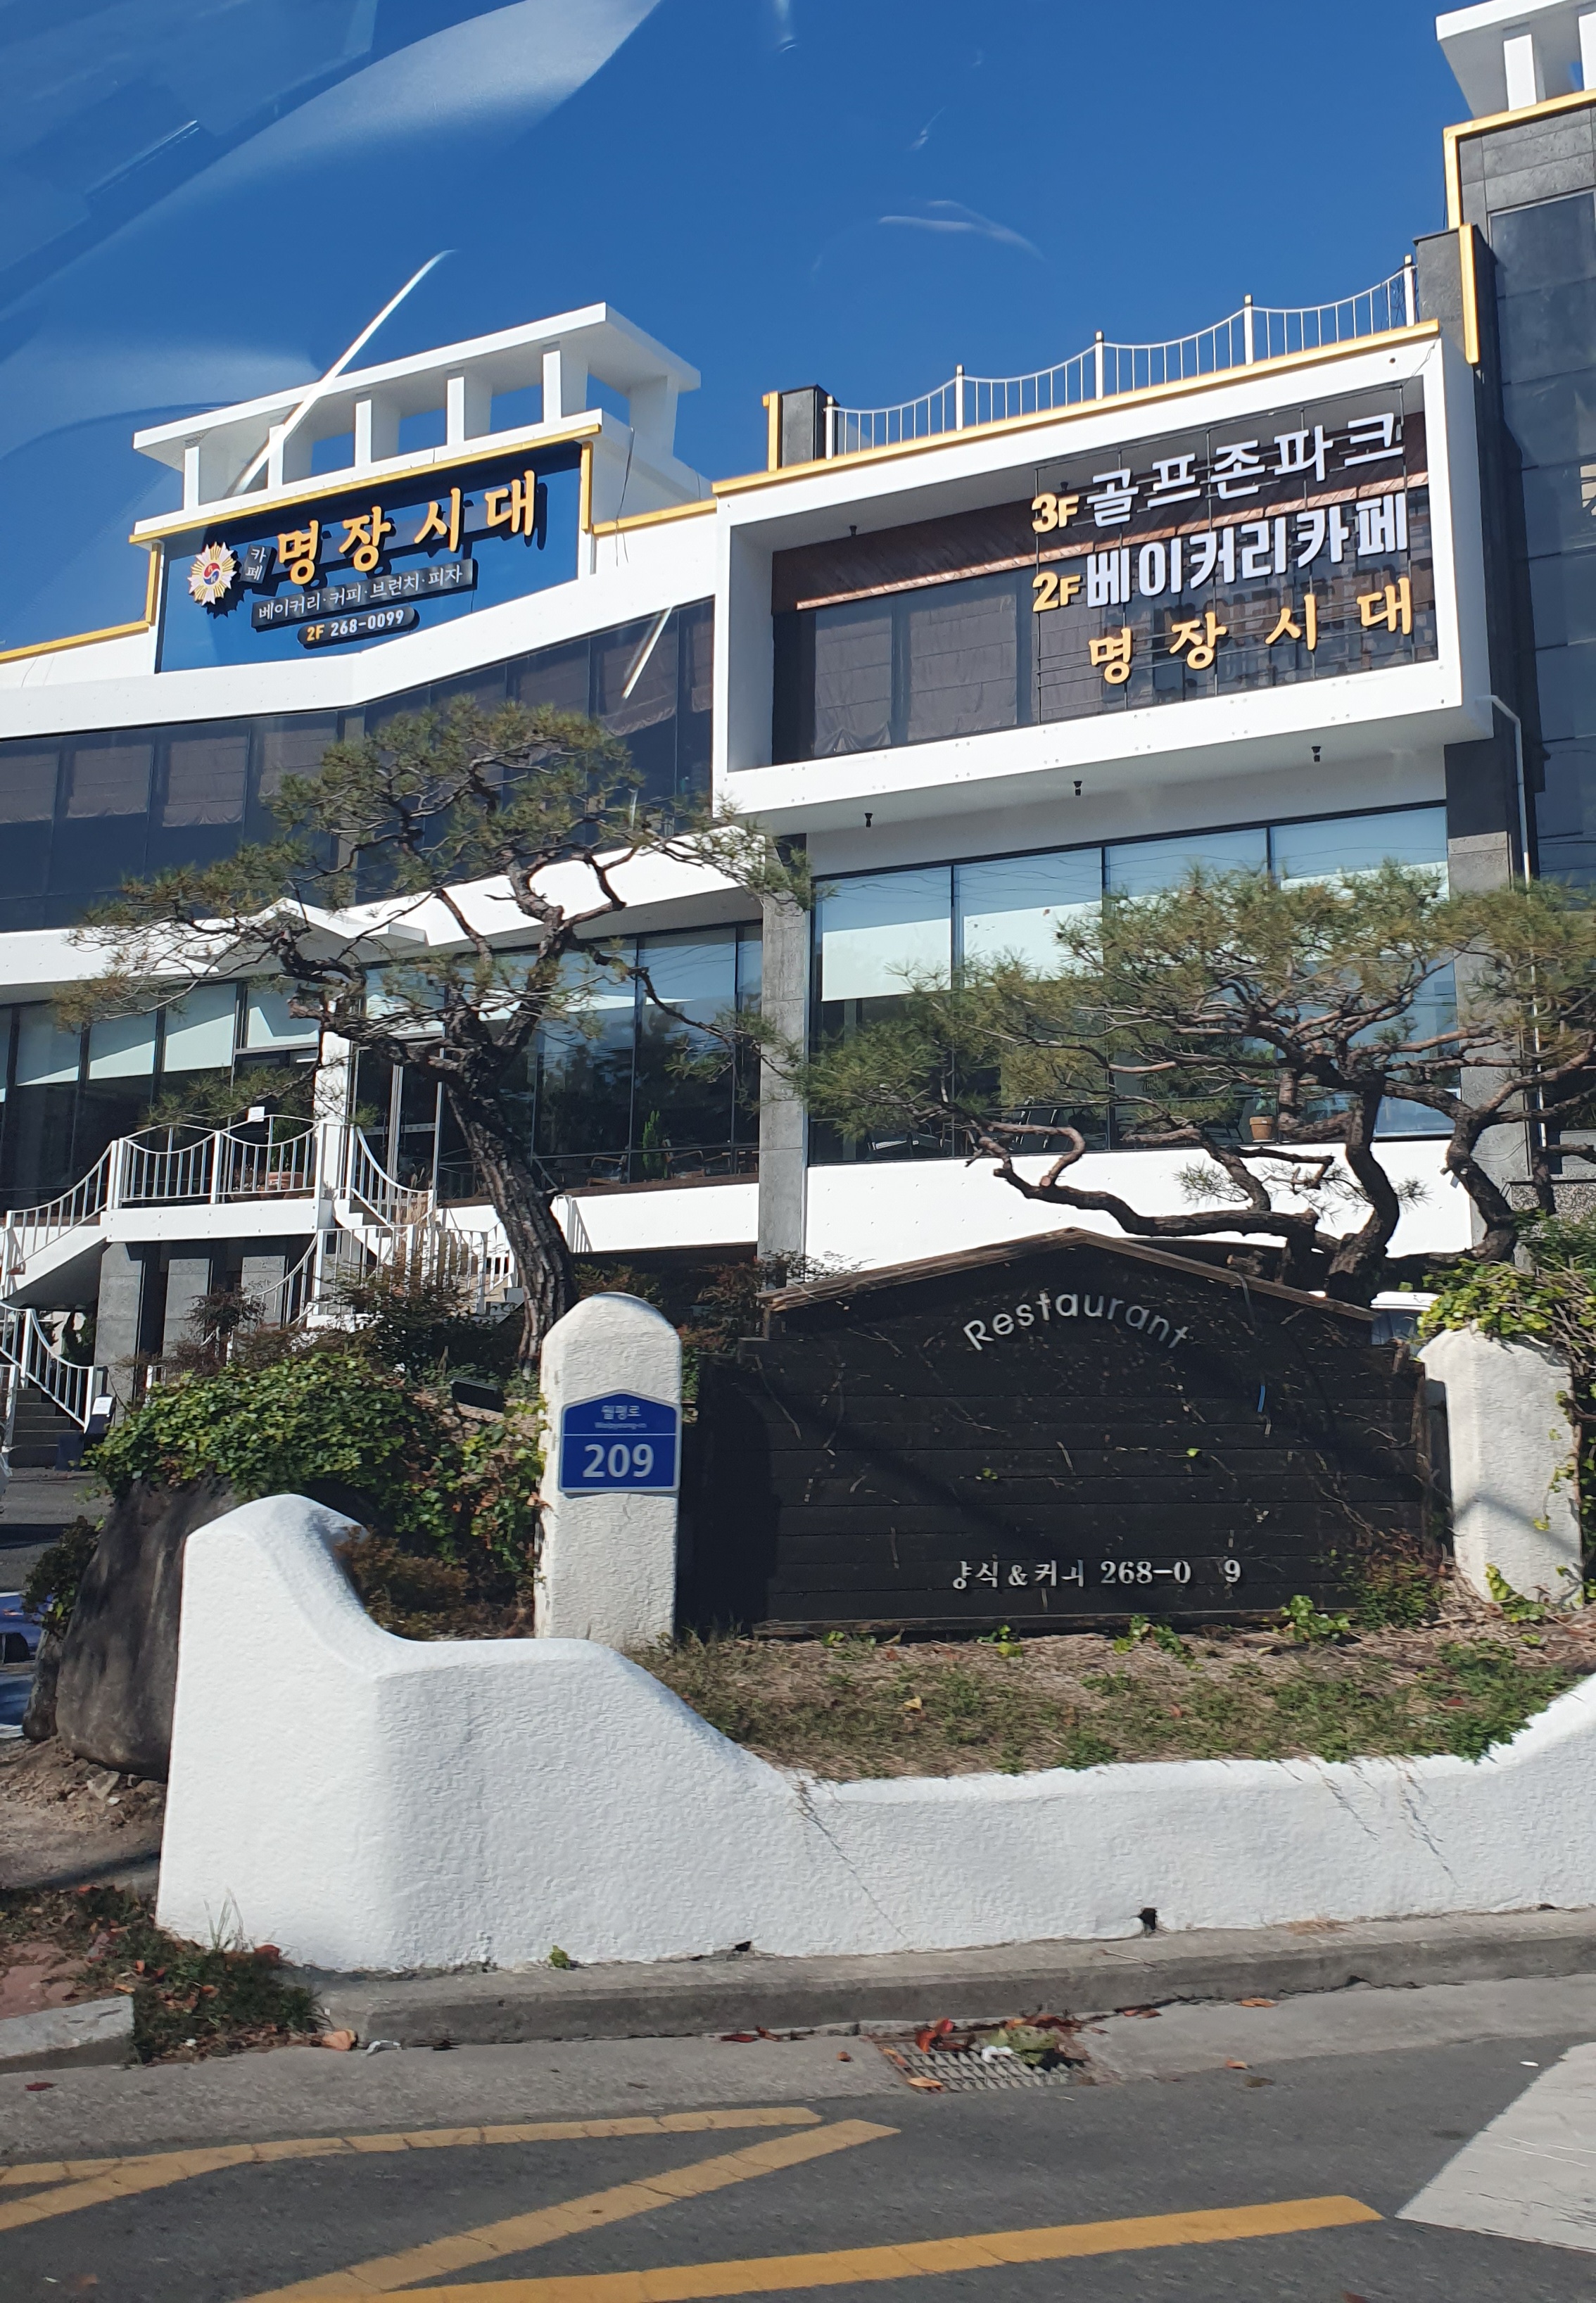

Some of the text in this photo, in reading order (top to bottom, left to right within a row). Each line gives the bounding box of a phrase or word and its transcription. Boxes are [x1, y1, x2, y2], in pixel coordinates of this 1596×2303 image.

[1031, 412, 1404, 533] 3F 골프존파크
[246, 546, 267, 581] 카페
[1032, 493, 1407, 613] 2F 베이커리카페
[306, 609, 405, 642] 2F 268-0099
[963, 1290, 1189, 1351] Restaurant
[583, 1443, 654, 1478] 209
